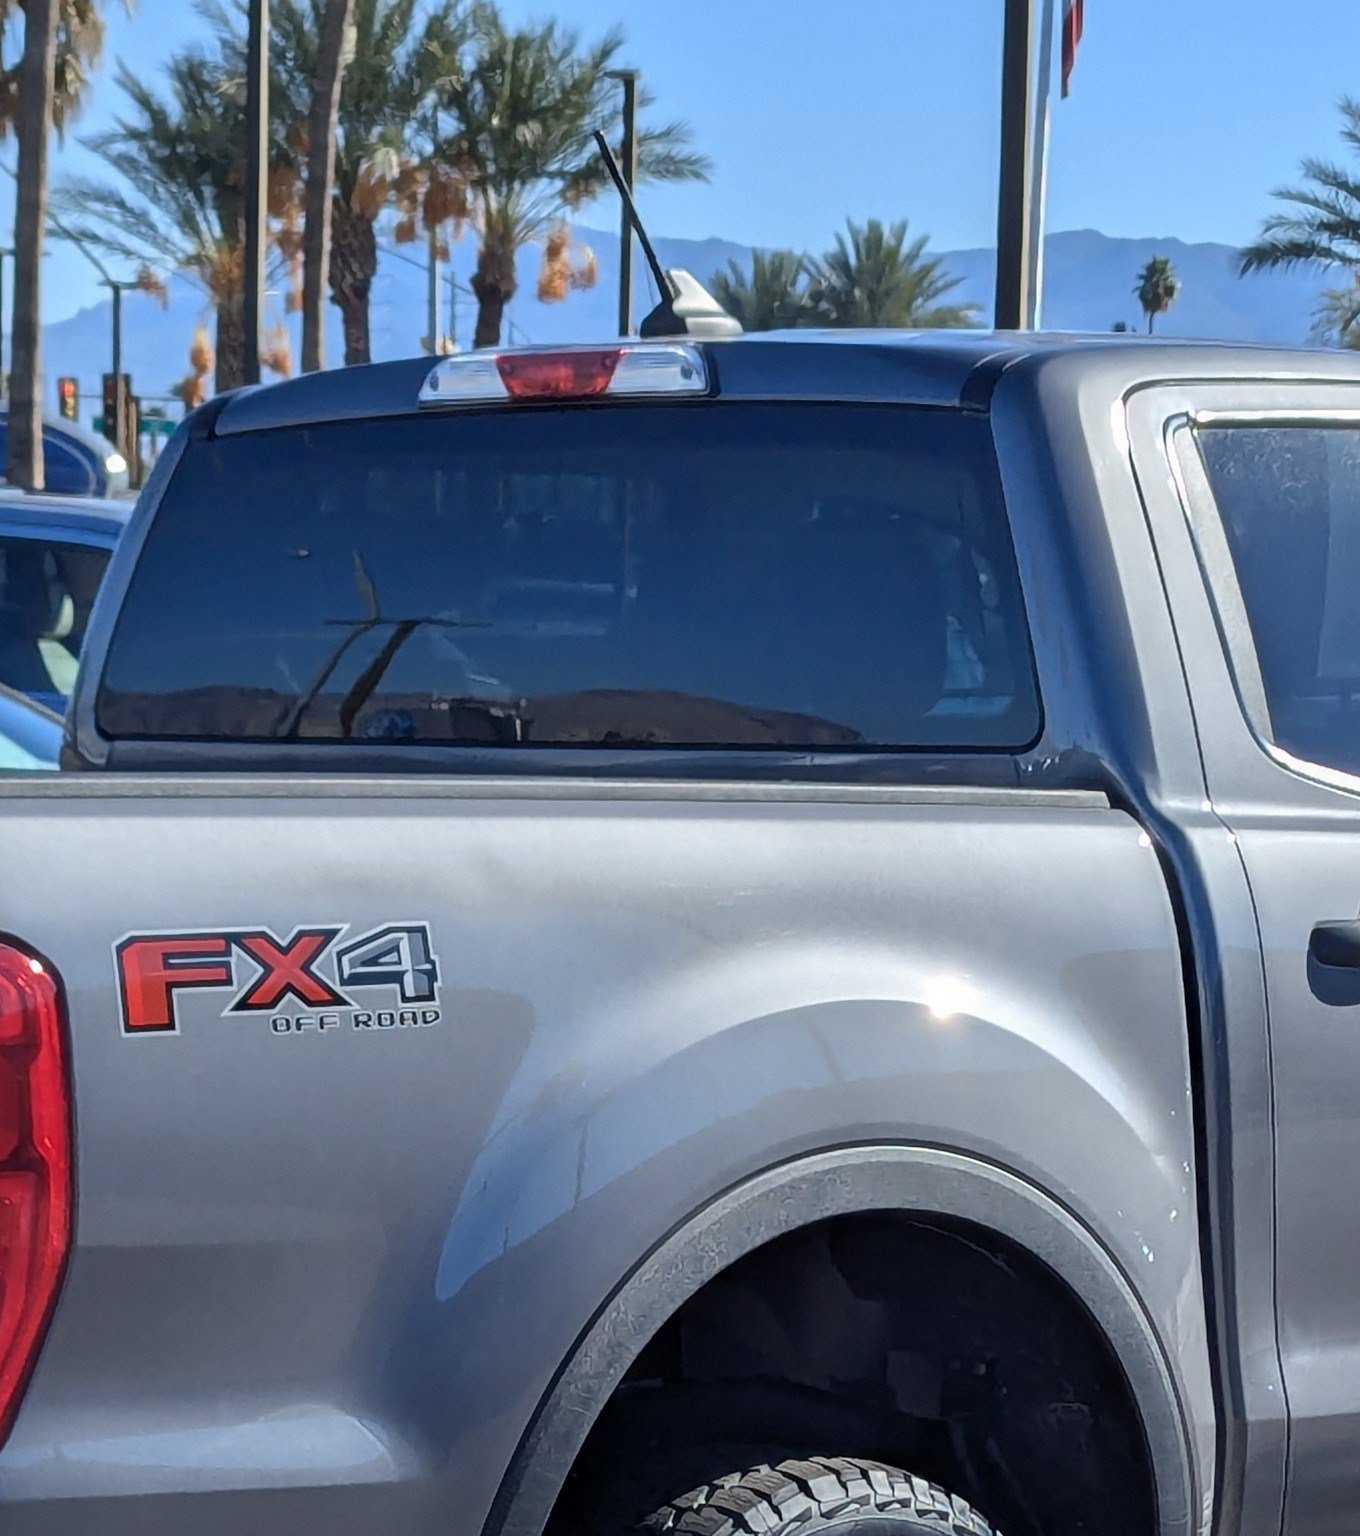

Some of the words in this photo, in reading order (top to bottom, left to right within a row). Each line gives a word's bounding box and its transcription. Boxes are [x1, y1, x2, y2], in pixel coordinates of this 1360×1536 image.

[111, 921, 442, 1038] FX4
[270, 1014, 340, 1035] OFF
[352, 1009, 442, 1033] ROAD
